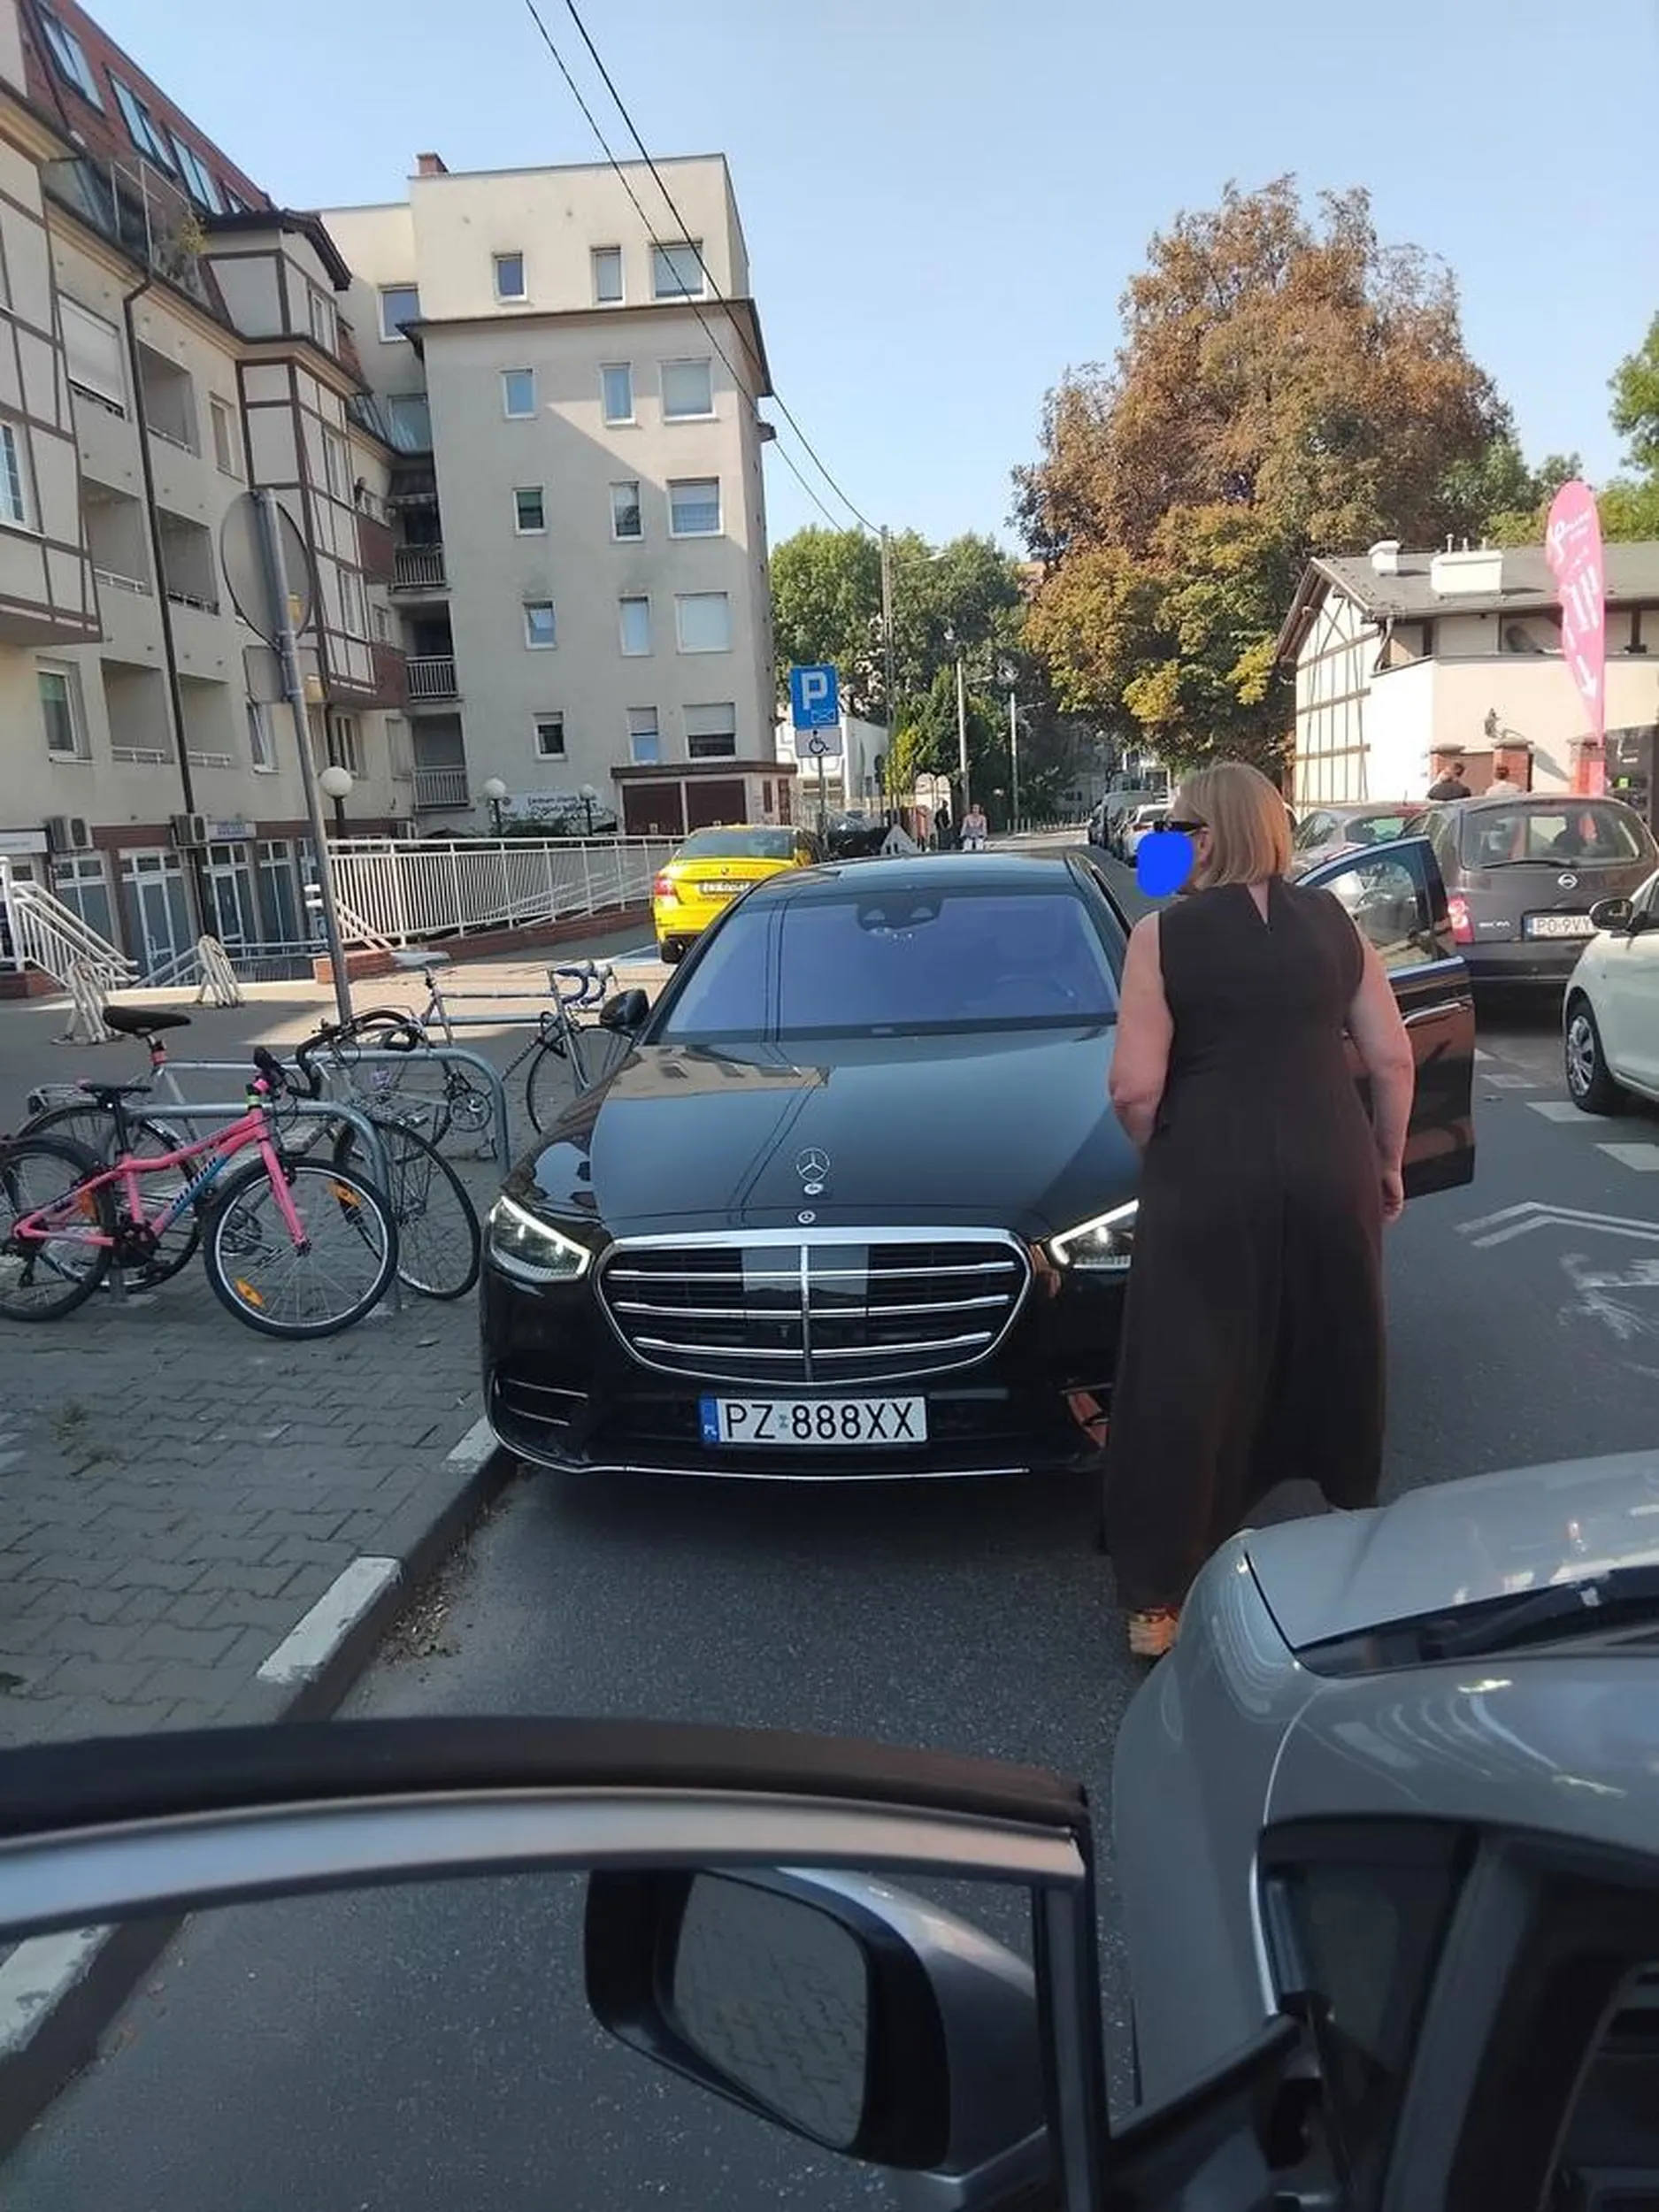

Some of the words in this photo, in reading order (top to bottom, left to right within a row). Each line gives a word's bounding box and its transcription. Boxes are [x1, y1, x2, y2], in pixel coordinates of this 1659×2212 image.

[801, 672, 828, 710] P
[726, 1403, 775, 1440] PZ
[792, 1402, 915, 1440] 888XX
